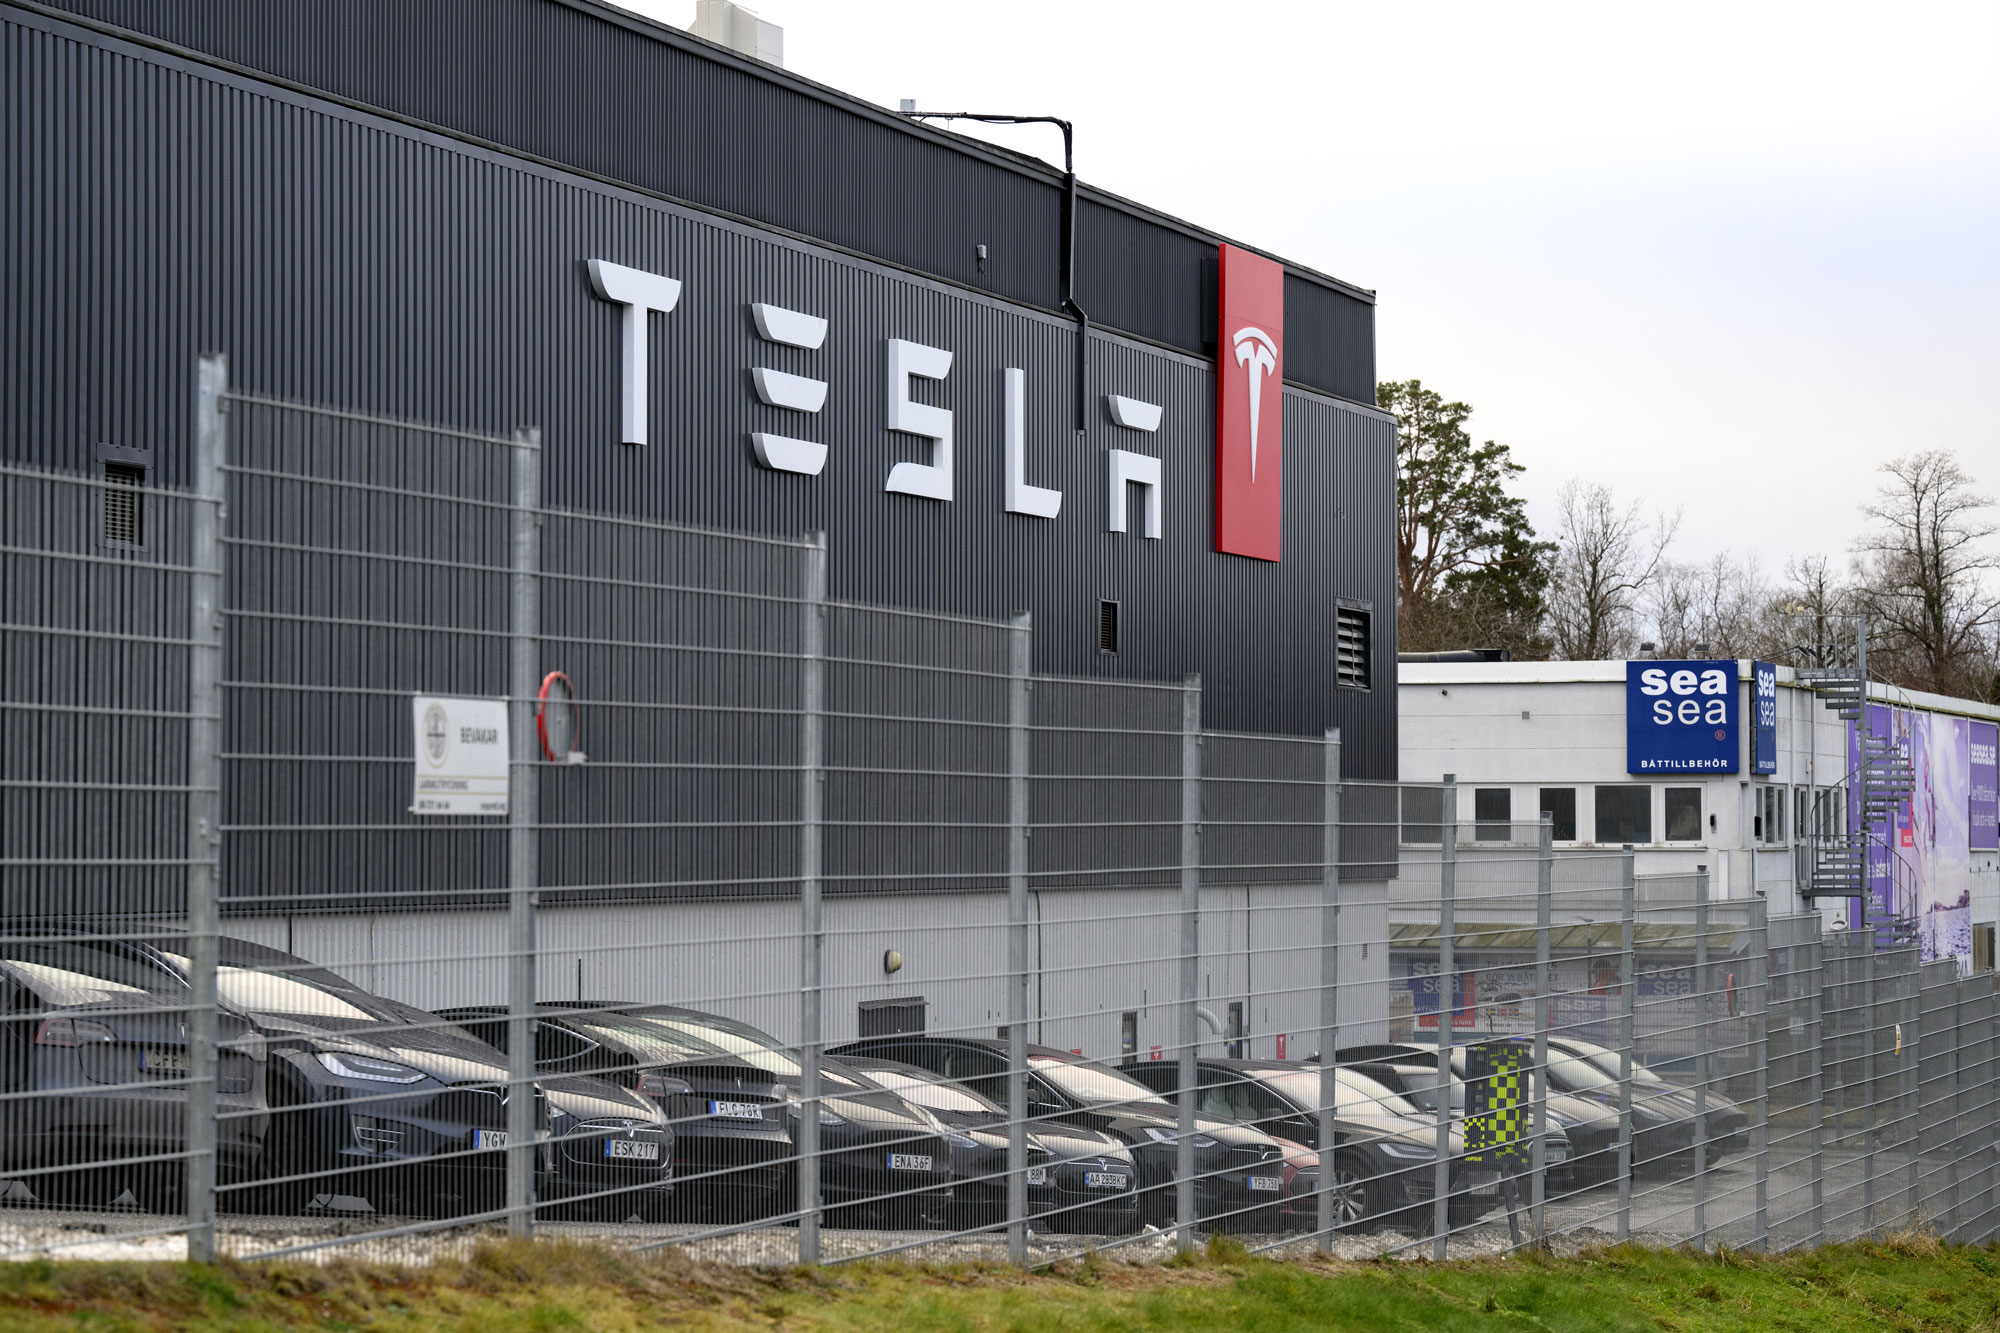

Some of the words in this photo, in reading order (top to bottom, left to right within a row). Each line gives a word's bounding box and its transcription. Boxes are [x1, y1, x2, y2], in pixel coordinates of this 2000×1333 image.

[588, 258, 1162, 540] TESLA
[1640, 668, 1728, 696] sea
[1758, 669, 1775, 698] sea
[1652, 699, 1727, 725] sea
[1760, 700, 1775, 727] sea
[1641, 758, 1728, 768] BÅTTILLBEHÖR
[1653, 981, 1691, 995] sea
[614, 1143, 635, 1157] ESK
[637, 1144, 656, 1158] 217
[895, 1155, 912, 1168] ENA
